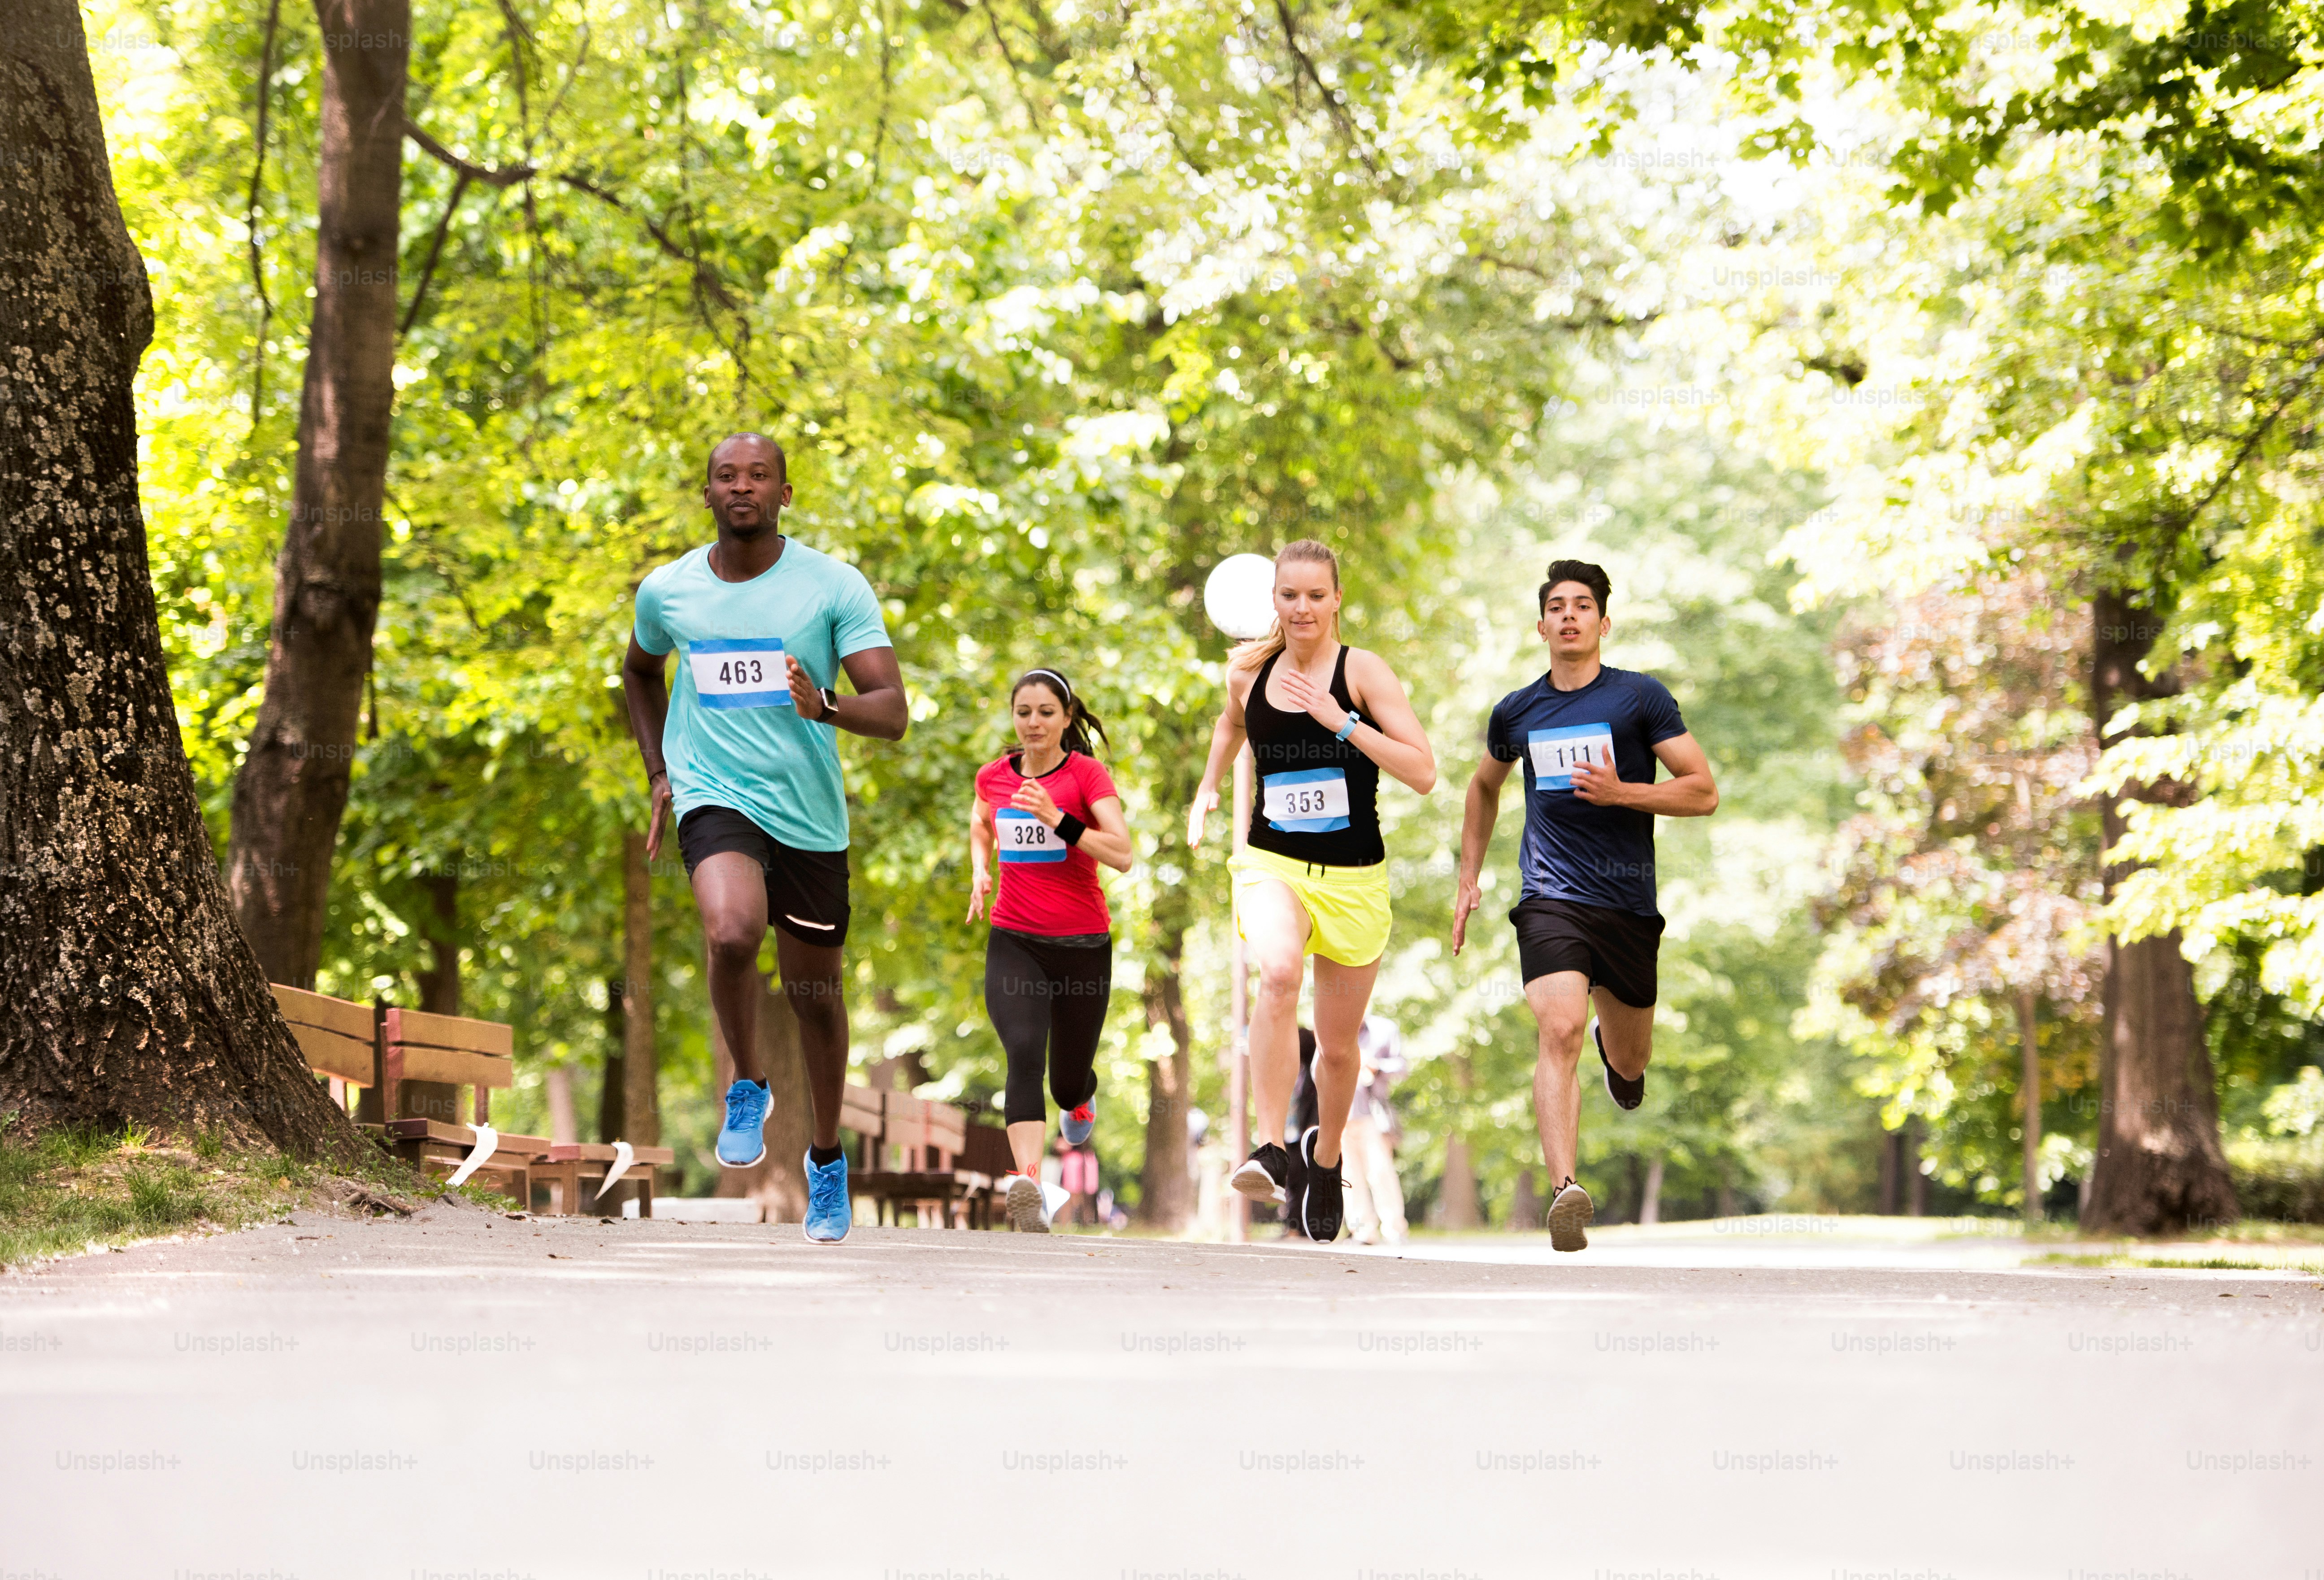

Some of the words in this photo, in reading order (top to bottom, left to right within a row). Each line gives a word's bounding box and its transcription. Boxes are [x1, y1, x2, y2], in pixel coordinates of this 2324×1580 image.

[719, 660, 762, 685] 463
[1557, 745, 1590, 767] 111
[1286, 790, 1325, 814] 353
[1015, 826, 1045, 844] 328
